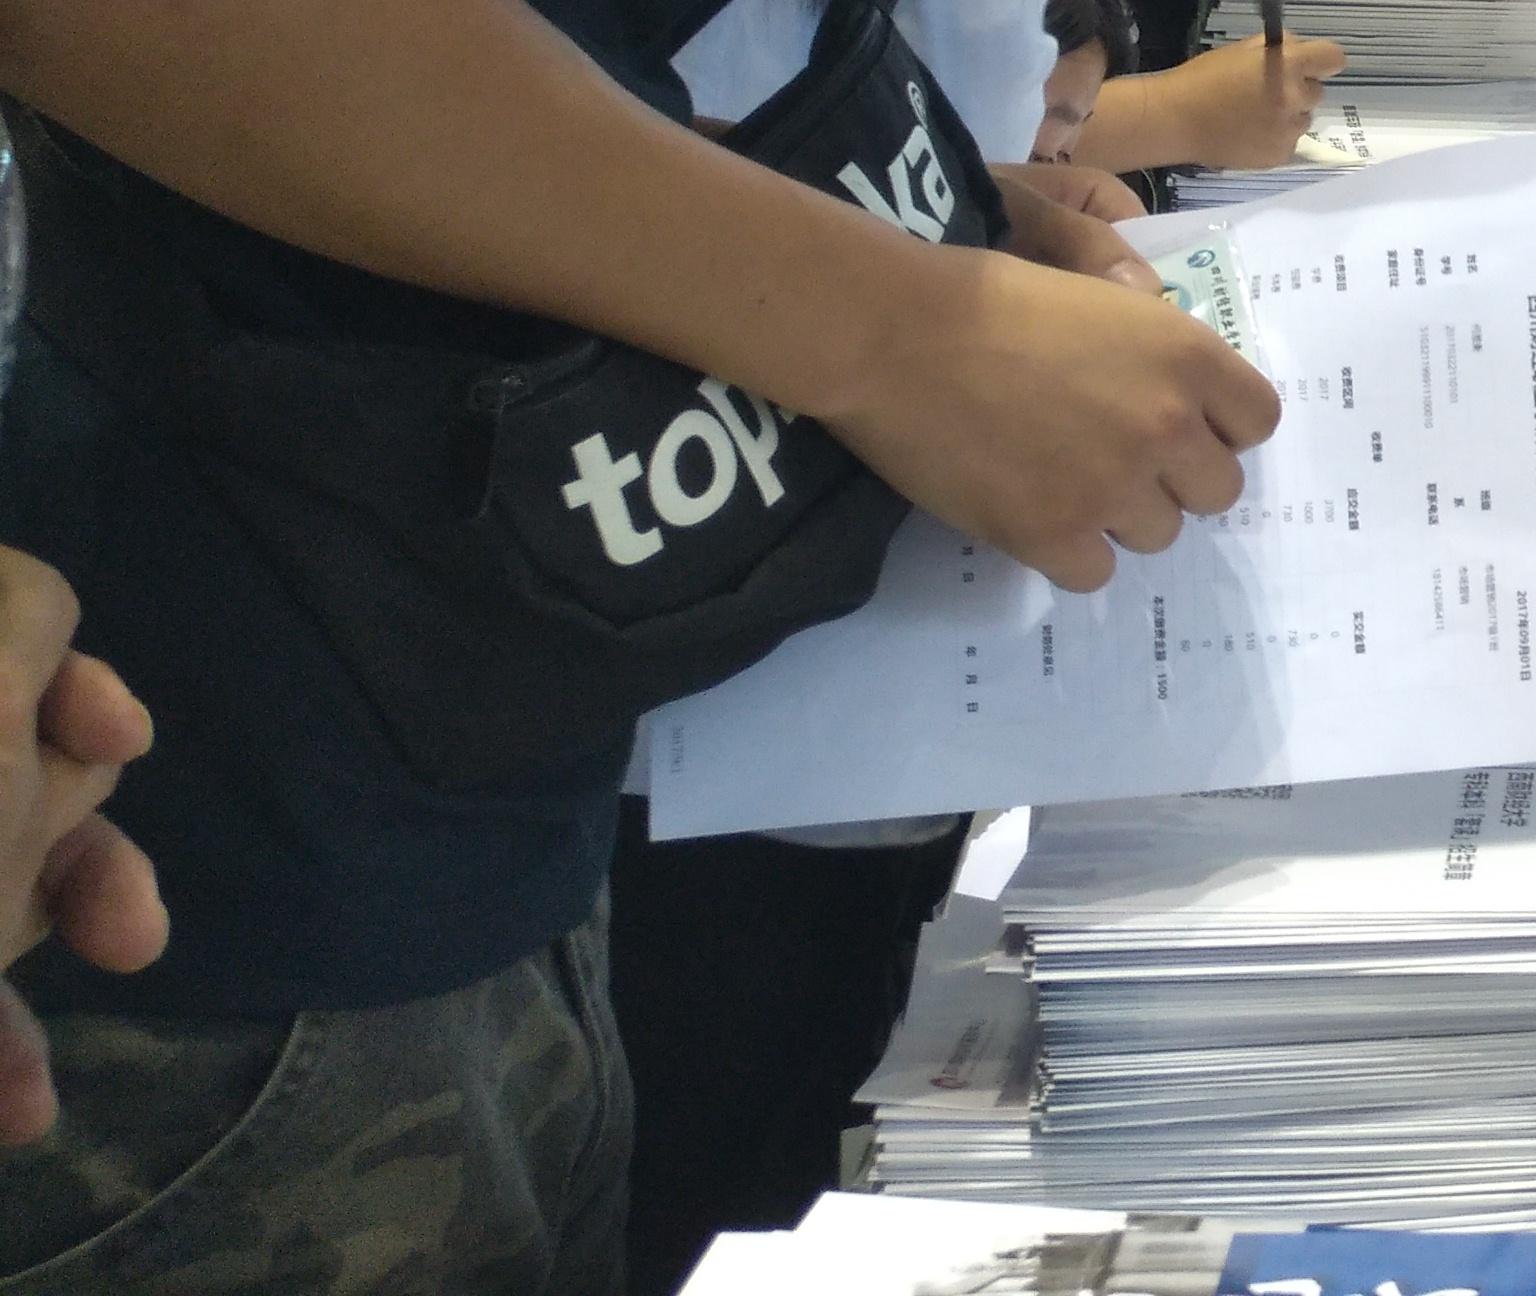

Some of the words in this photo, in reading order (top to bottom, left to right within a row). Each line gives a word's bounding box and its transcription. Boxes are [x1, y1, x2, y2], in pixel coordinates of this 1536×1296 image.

[1387, 249, 1400, 288] 家庭住址
[1414, 248, 1427, 286] 身份证号
[1441, 255, 1453, 275] 学号
[1467, 254, 1478, 274] 姓名
[1298, 379, 1308, 402] 2017
[1318, 377, 1329, 401] 2017
[1341, 367, 1354, 409] 收费区间
[1347, 488, 1360, 531] 应交金额
[1426, 483, 1439, 526] 联系电话
[1353, 611, 1366, 654] 实交金额
[1516, 589, 1532, 682] 2017年09月01日
[1500, 772, 1535, 827] 西南财经大学
